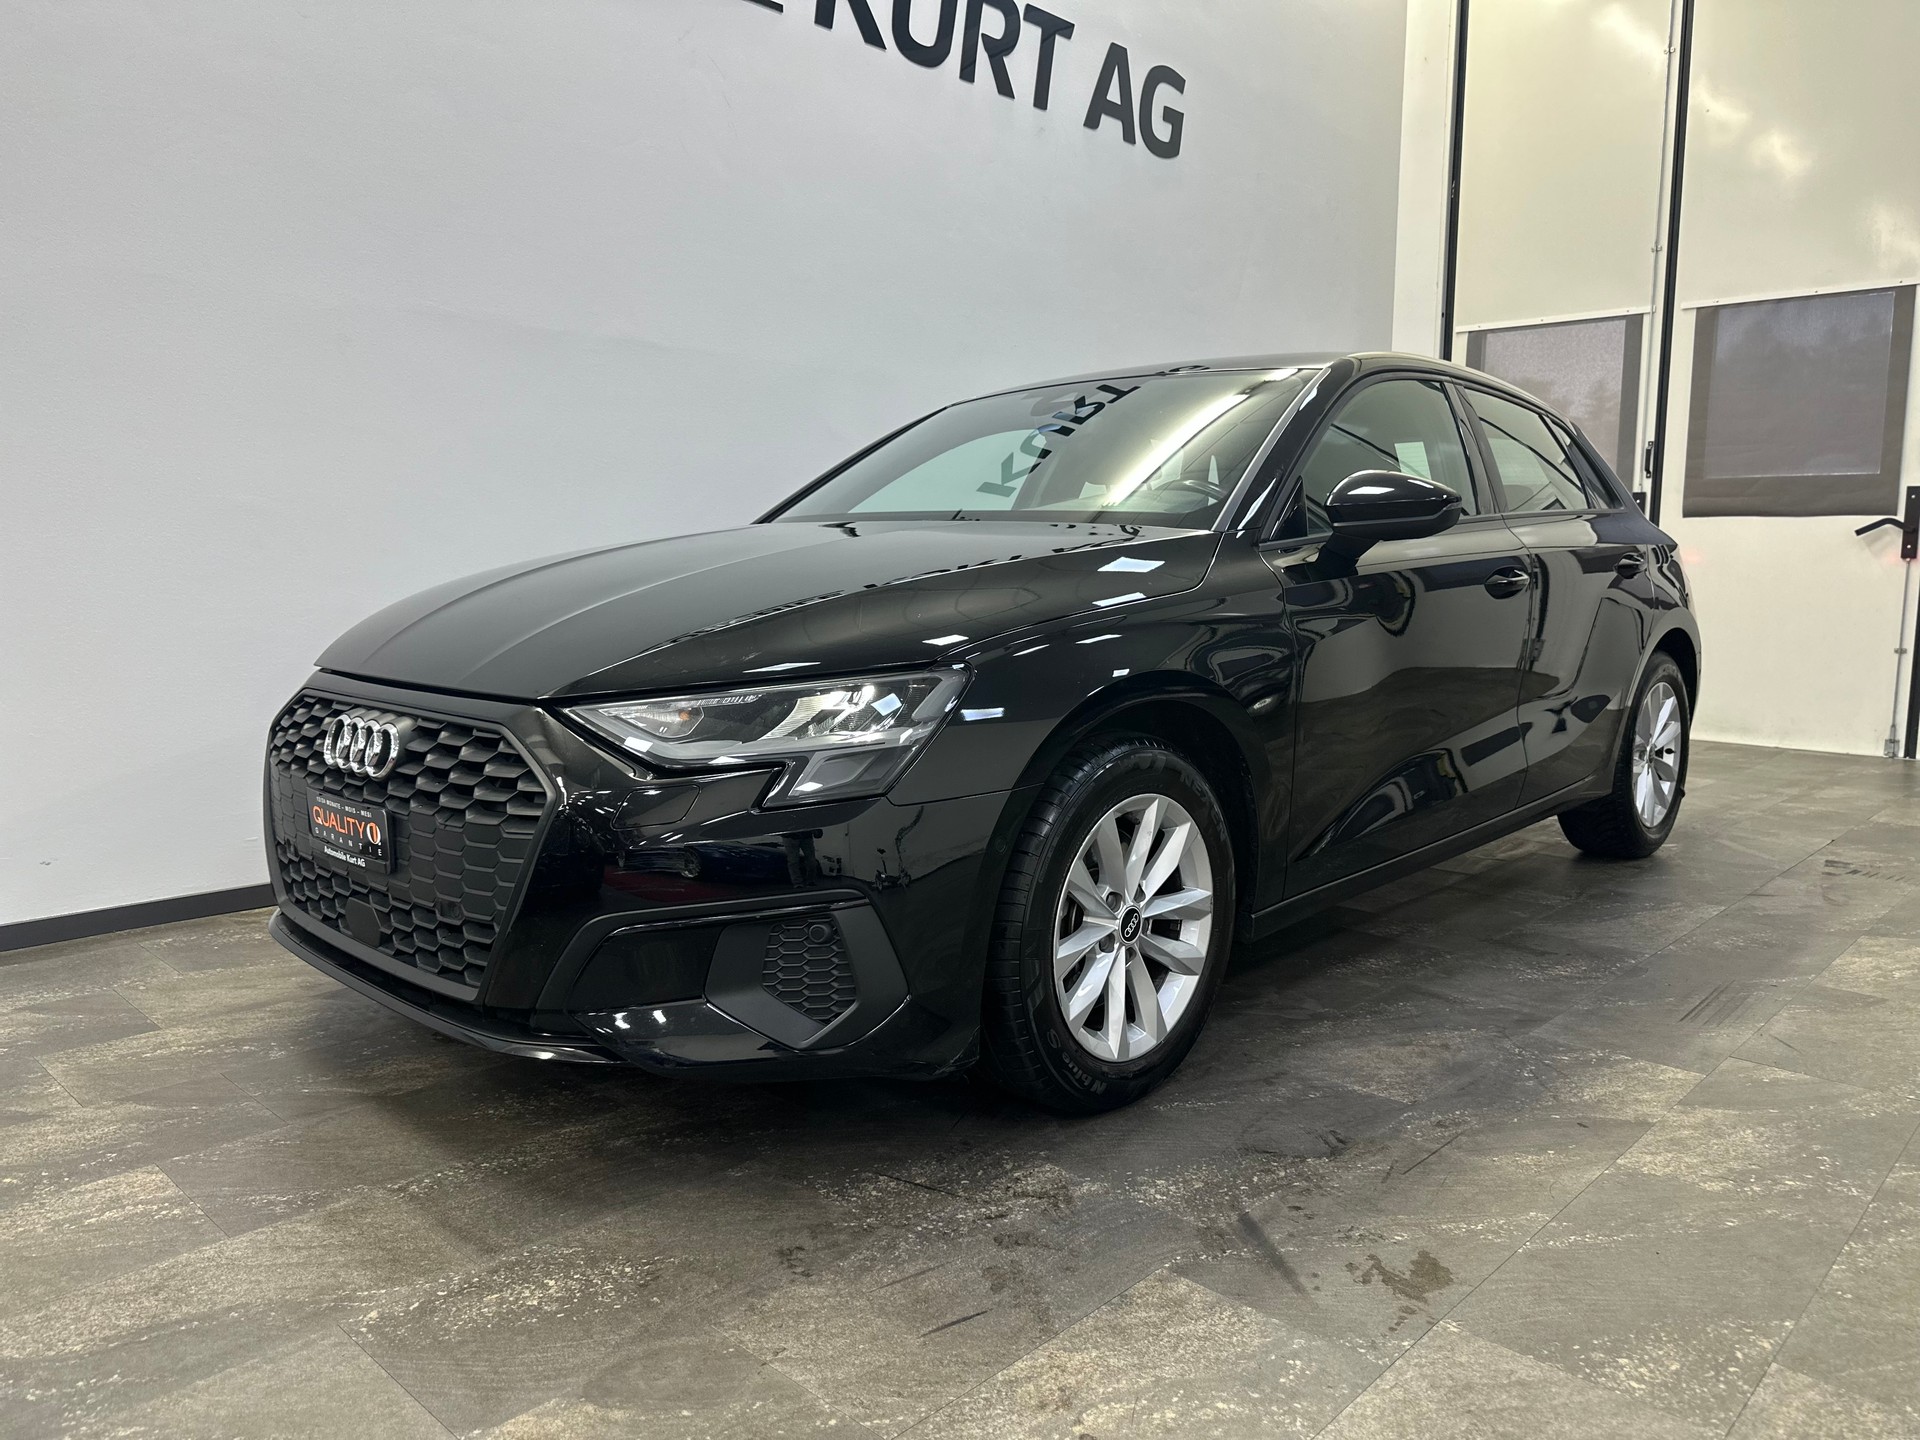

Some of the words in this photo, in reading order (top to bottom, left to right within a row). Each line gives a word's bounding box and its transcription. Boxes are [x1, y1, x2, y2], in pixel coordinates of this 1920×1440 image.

[1083, 42, 1186, 158] AG
[312, 805, 365, 839] QUALITY
[315, 827, 382, 856] GARANTIE
[324, 845, 347, 861] Automobile
[346, 853, 358, 865] Kurt
[357, 857, 366, 868] AG
